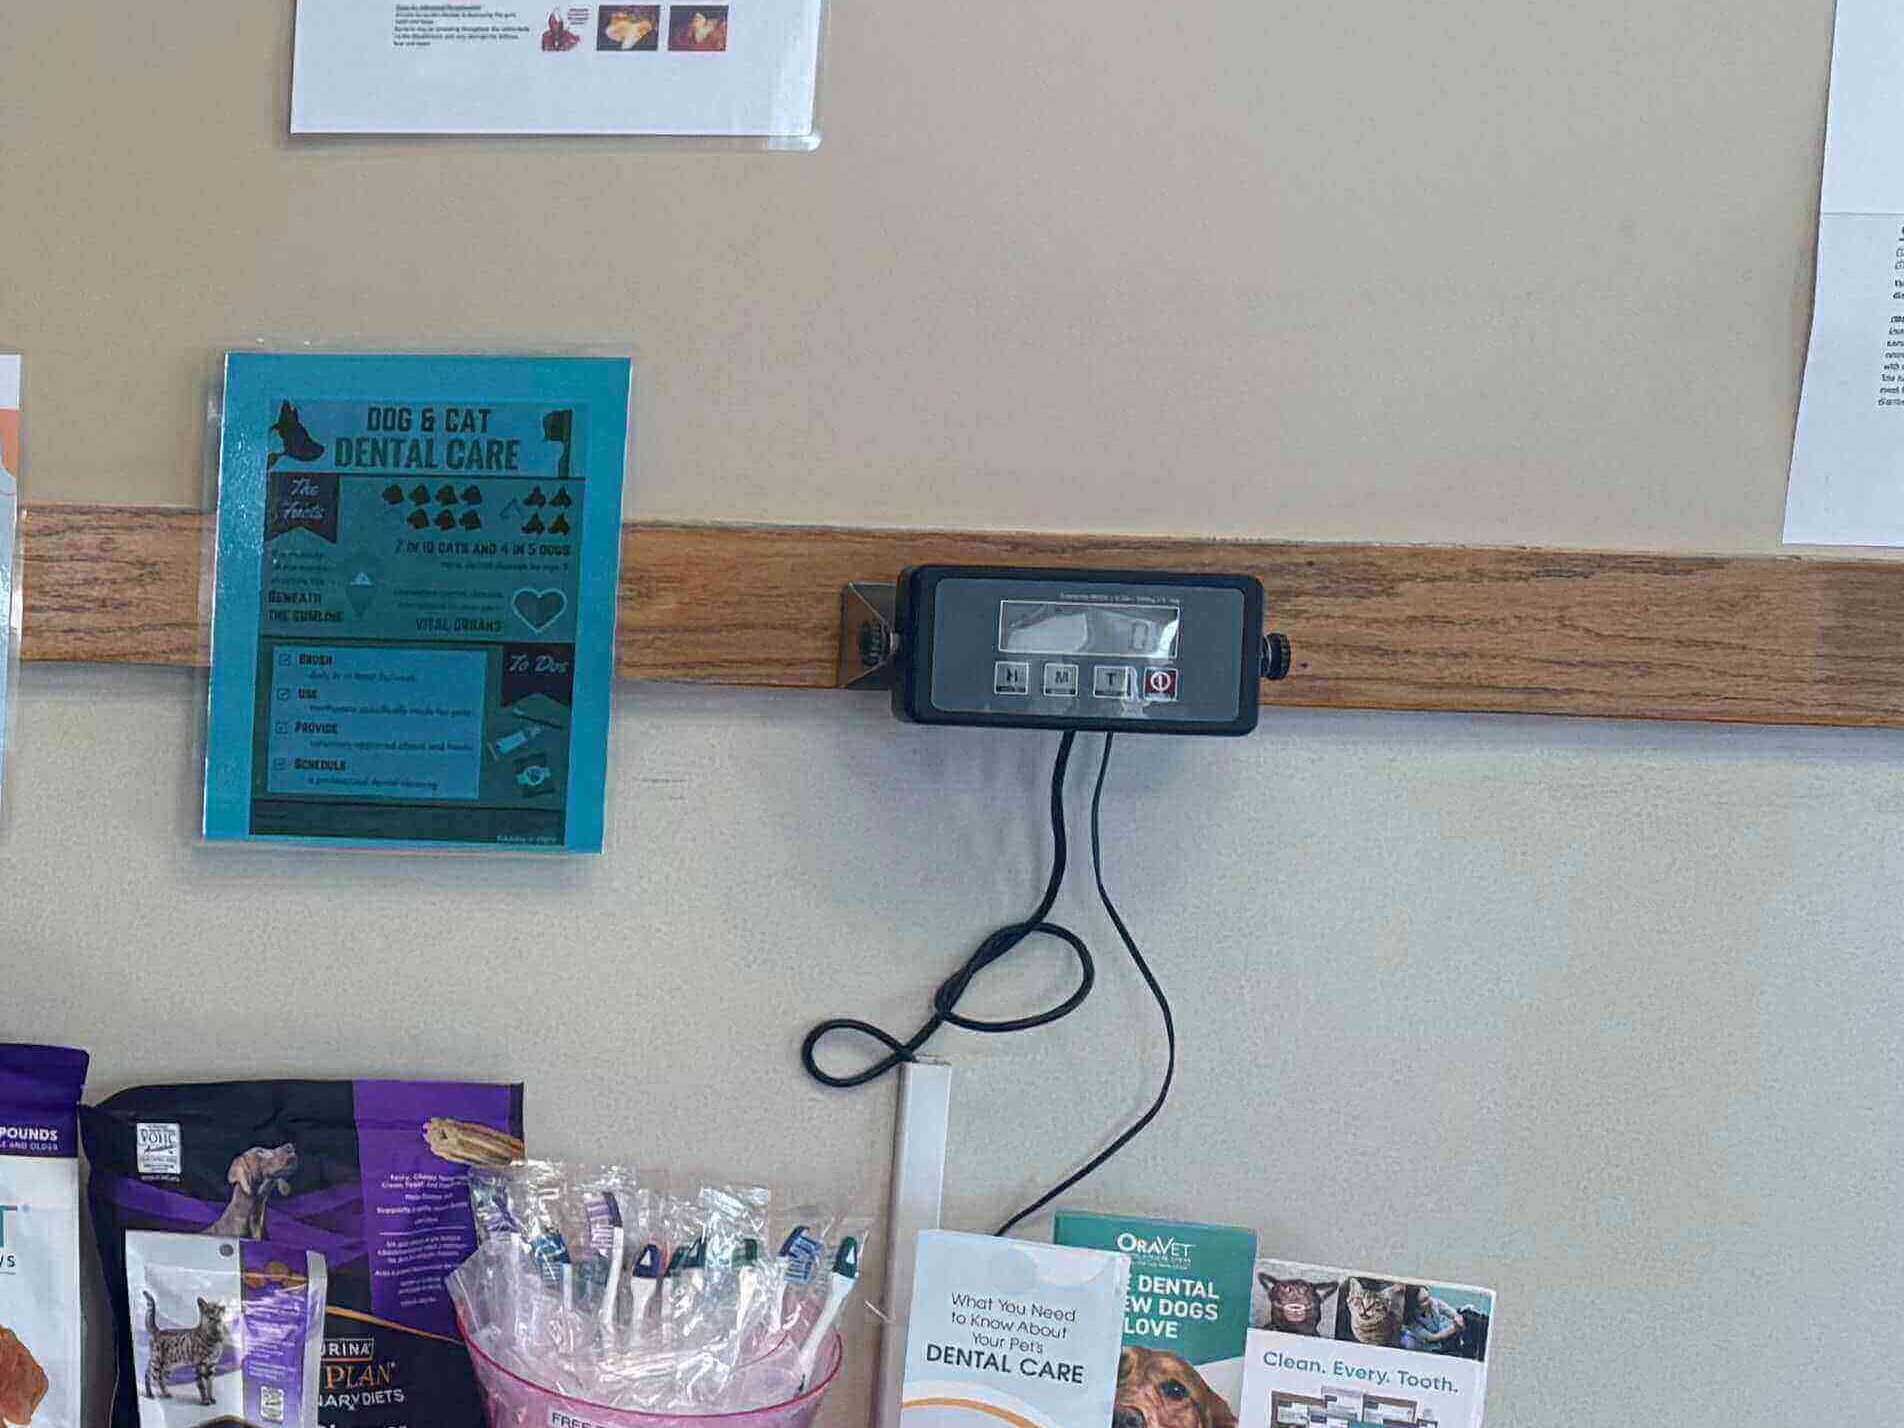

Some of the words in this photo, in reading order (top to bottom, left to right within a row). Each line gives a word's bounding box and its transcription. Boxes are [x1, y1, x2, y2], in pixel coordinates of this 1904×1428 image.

[367, 407, 416, 433] DOG
[420, 407, 436, 432] &
[444, 408, 493, 433] CAT
[334, 437, 442, 469] DENTAL
[451, 437, 521, 471] CARE
[508, 654, 530, 672] To
[1138, 1275, 1220, 1299] DENTAL
[951, 1292, 993, 1312] What
[998, 1298, 1026, 1316] You
[1031, 1303, 1077, 1323] Need
[1159, 1299, 1218, 1321] DOGS
[951, 1312, 966, 1326] to
[970, 1313, 1014, 1332] Know
[1017, 1319, 1068, 1340] About
[1124, 1317, 1178, 1338] LOVE
[972, 1331, 1006, 1349] Your
[1010, 1336, 1044, 1354] Pet's
[326, 1363, 392, 1389] PLAN
[927, 1344, 1013, 1374] DENTAL
[1019, 1356, 1084, 1385] CARE
[1262, 1350, 1327, 1374] Clean.
[1333, 1360, 1391, 1385] Every.
[1397, 1369, 1459, 1394] Tooth.
[362, 1388, 405, 1406] DIETS
